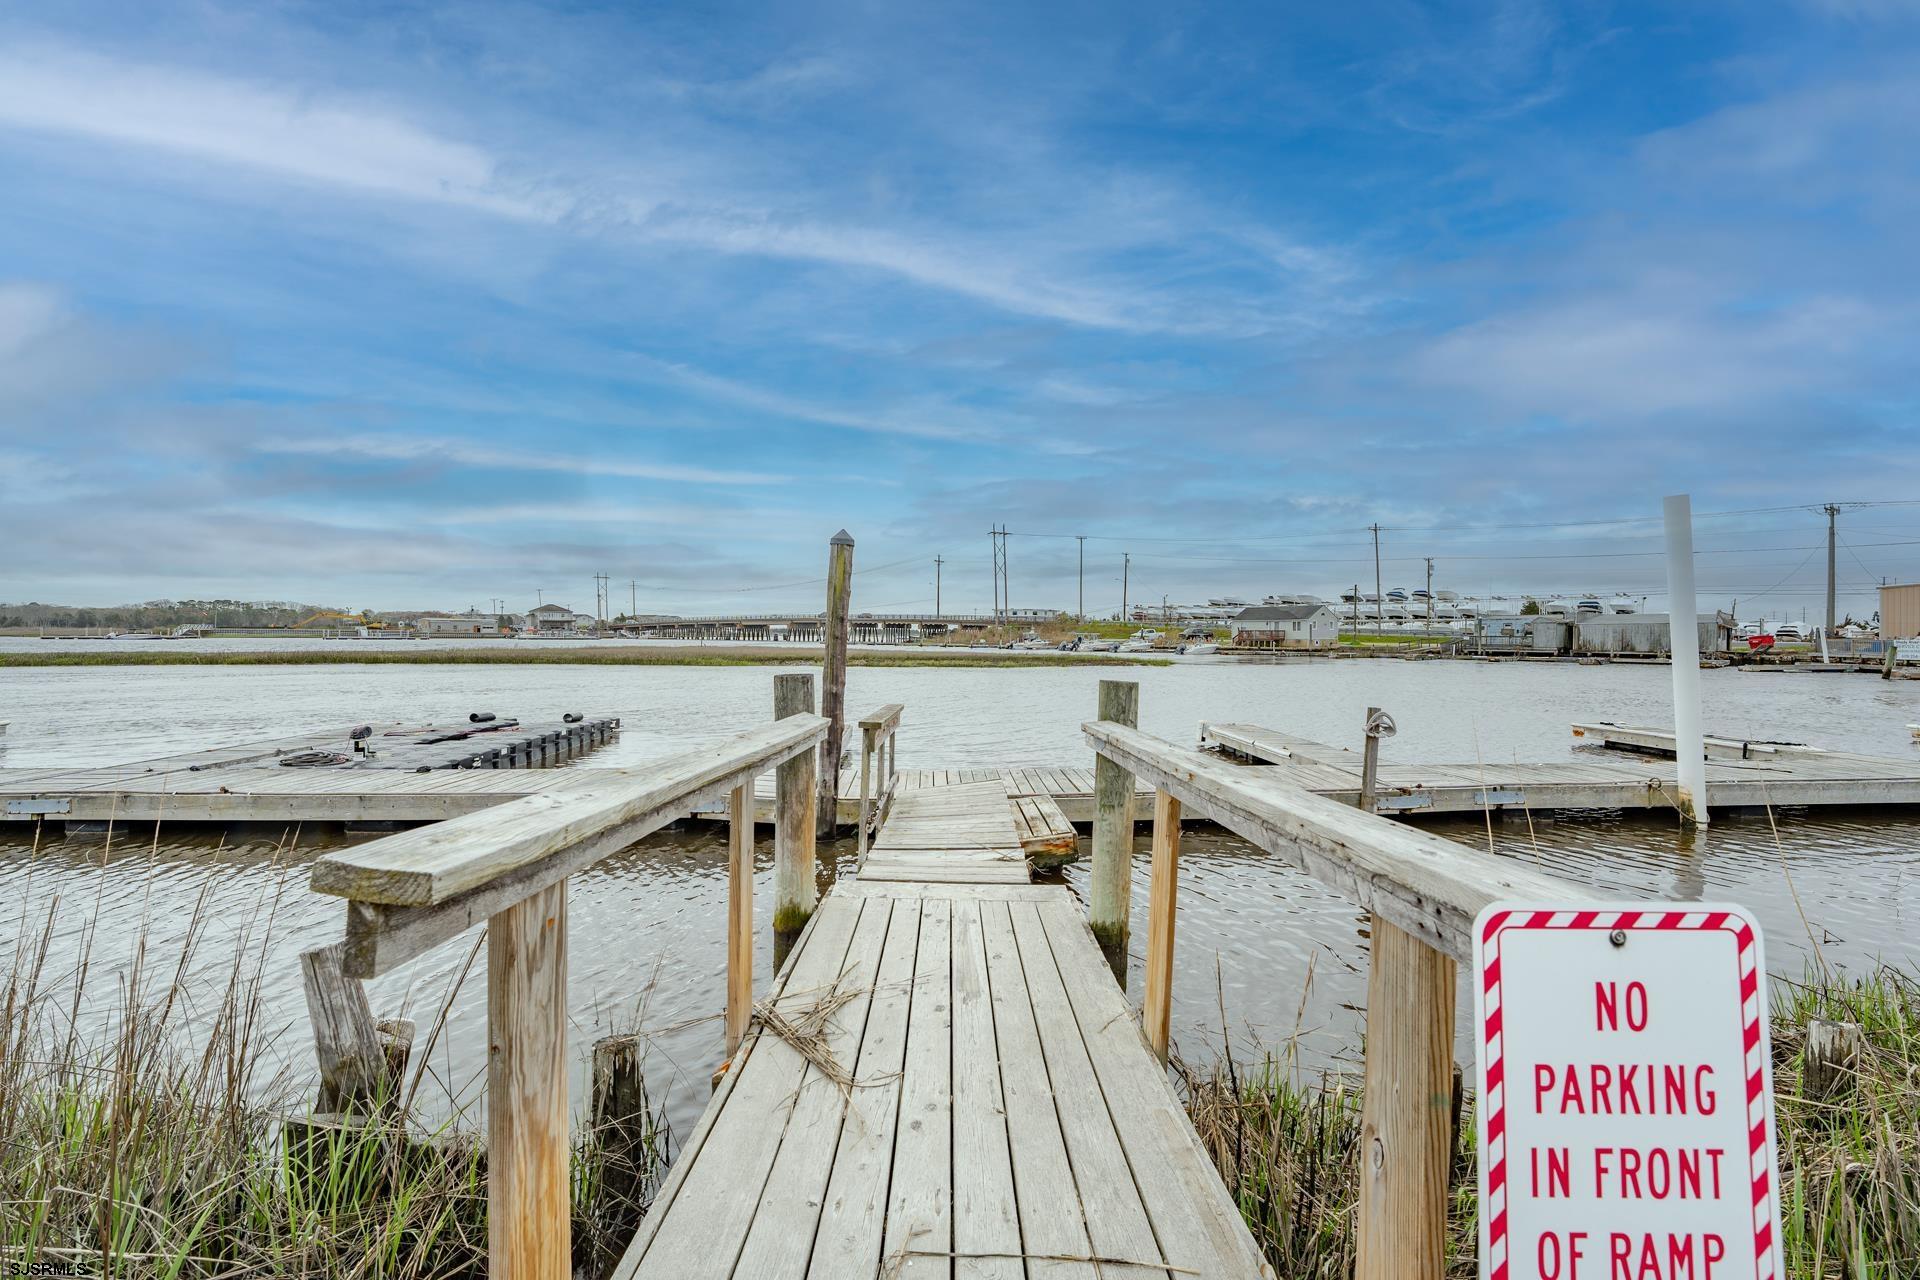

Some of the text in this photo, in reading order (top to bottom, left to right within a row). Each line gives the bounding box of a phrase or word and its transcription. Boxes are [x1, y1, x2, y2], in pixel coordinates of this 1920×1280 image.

[1594, 980, 1649, 1033] NO
[1533, 1062, 1717, 1117] PARKING
[1530, 1146, 1725, 1201] IN FRONT
[1536, 1230, 1726, 1280] OF RAMP
